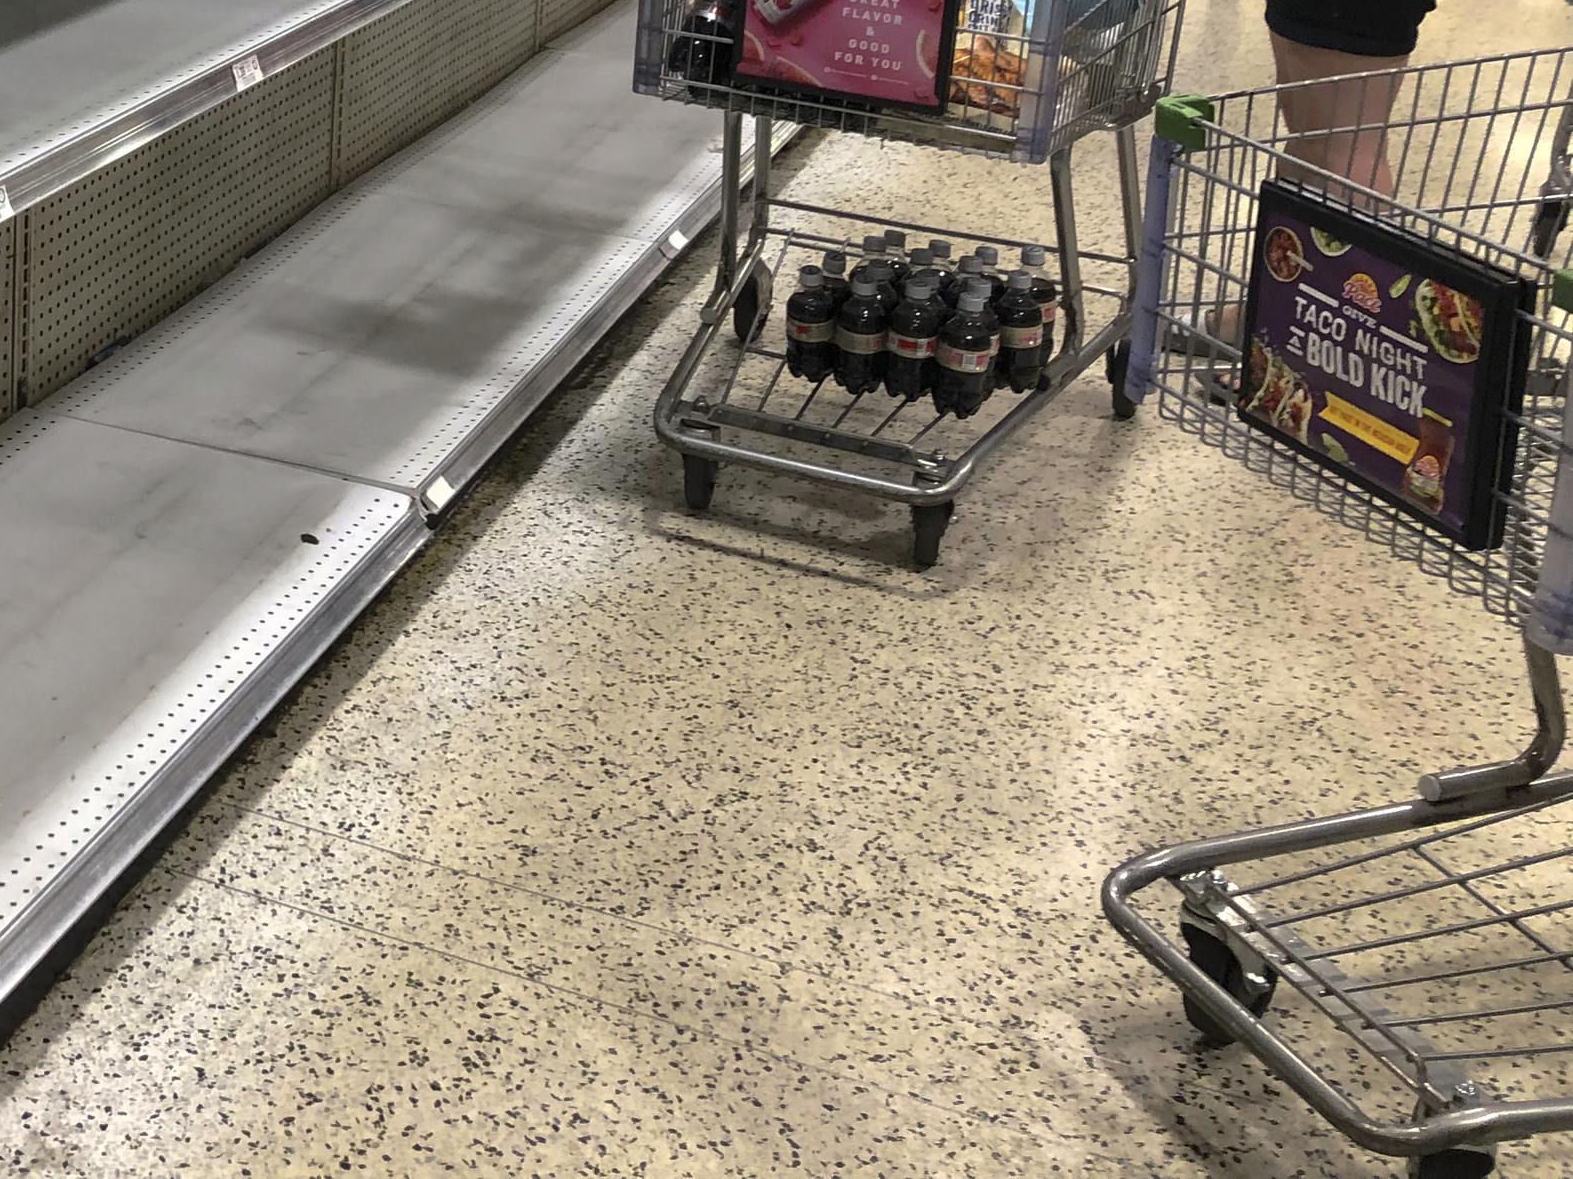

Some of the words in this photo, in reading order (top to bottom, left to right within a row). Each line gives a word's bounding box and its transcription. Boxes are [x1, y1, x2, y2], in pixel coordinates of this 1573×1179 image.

[842, 7, 903, 26] FLAVOR
[865, 26, 876, 37] &
[848, 39, 891, 54] GOOD
[834, 51, 865, 66] FOR
[871, 57, 903, 72] YOU
[1295, 296, 1348, 342] TACO
[1355, 329, 1428, 380] NIGHT
[1307, 332, 1365, 388] BOLD
[1370, 363, 1427, 418] KICK
